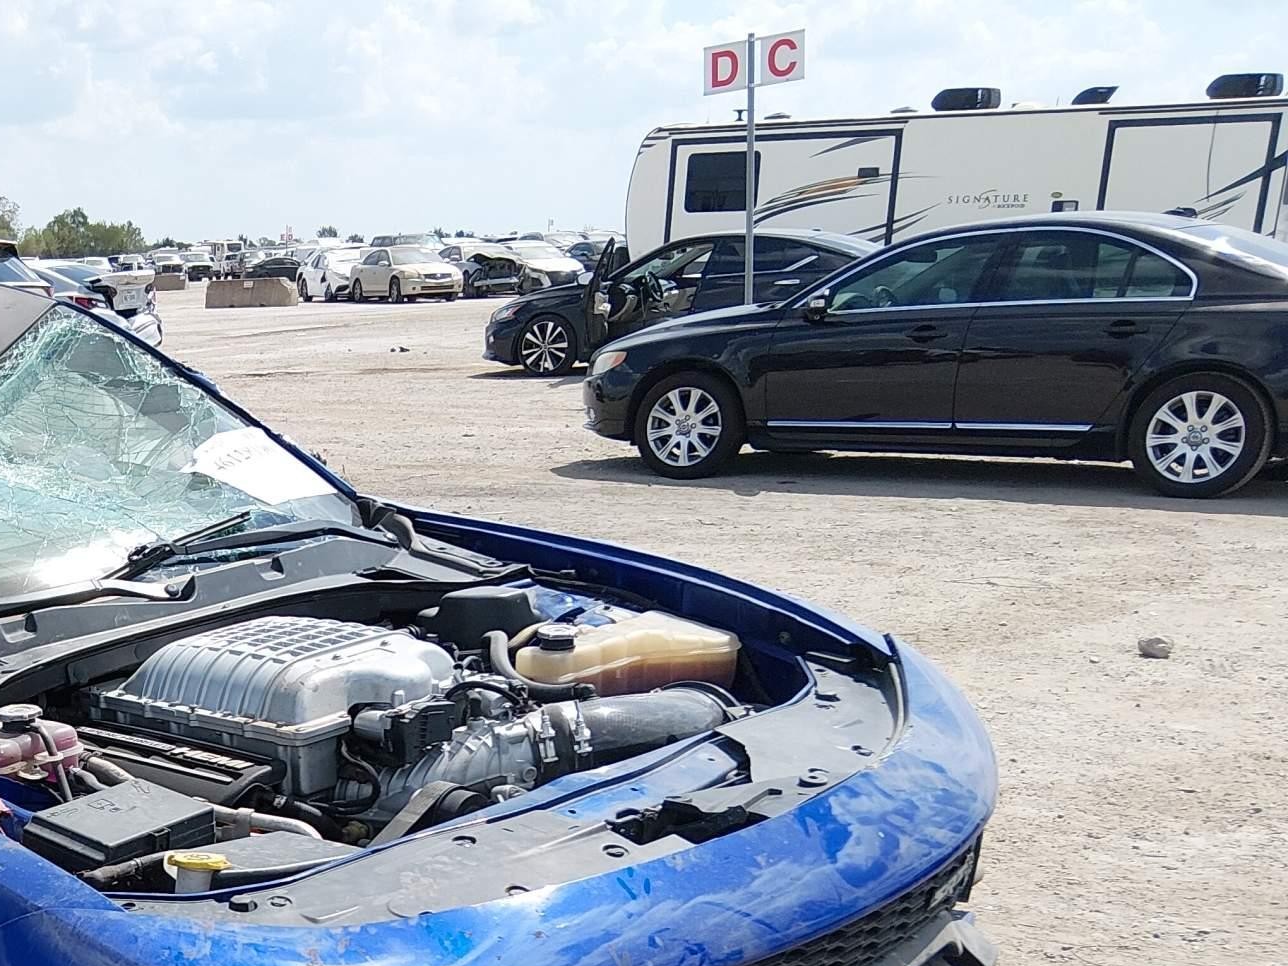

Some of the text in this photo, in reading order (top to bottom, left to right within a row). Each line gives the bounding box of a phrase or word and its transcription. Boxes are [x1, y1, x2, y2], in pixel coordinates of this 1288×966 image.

[711, 38, 798, 88] D C
[947, 191, 1029, 206] SIGNATURE
[169, 747, 255, 769] HEMI
